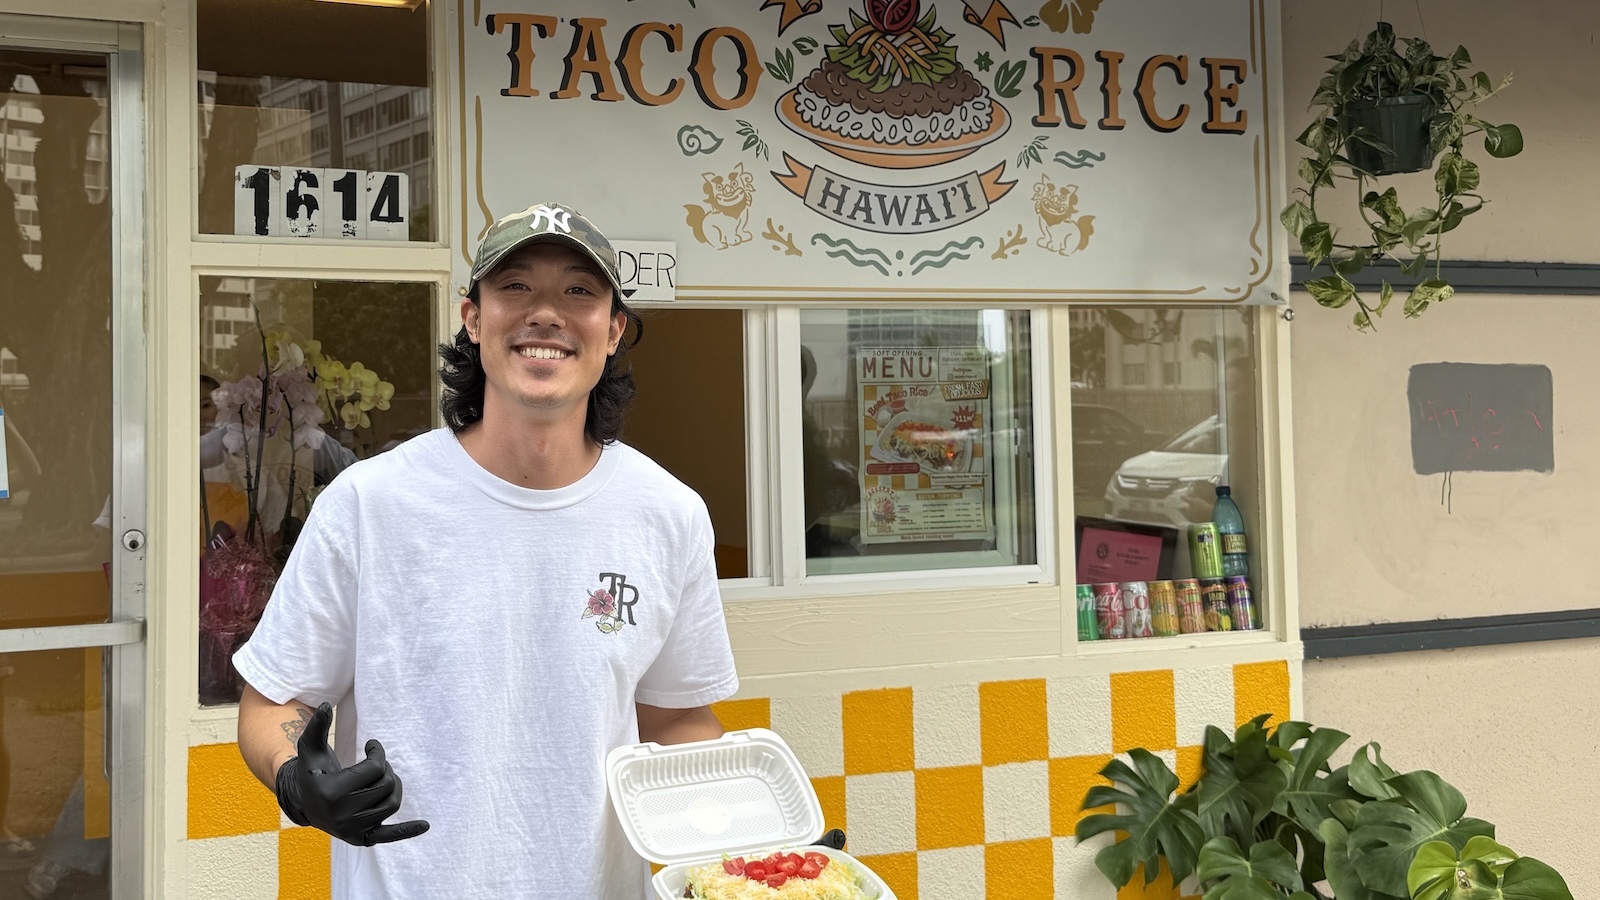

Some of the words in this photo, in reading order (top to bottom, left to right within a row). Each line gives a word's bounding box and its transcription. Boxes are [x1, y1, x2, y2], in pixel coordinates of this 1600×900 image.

[485, 13, 764, 111] TACO
[1031, 46, 1247, 135] RICE
[242, 168, 404, 237] 1614
[530, 206, 572, 235] NY
[863, 357, 932, 378] MENU
[885, 391, 907, 402] Taco
[599, 572, 639, 626] TR
